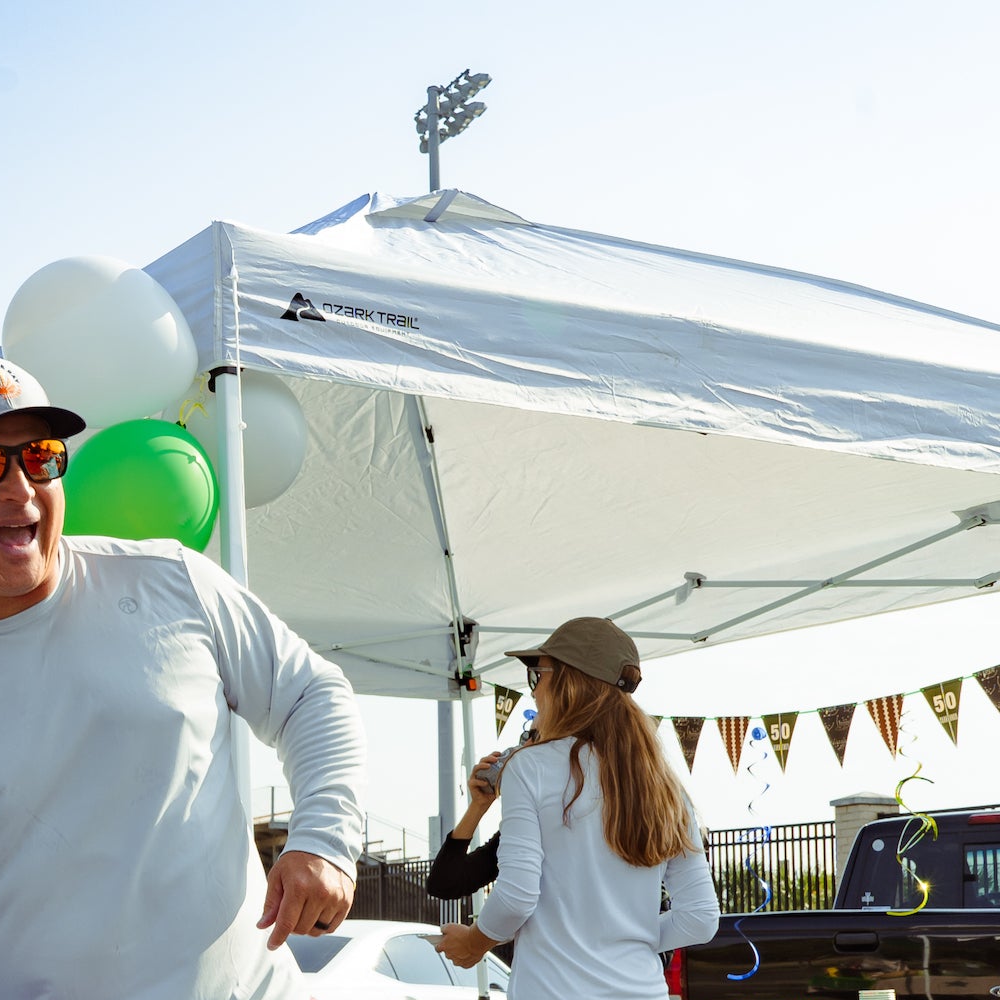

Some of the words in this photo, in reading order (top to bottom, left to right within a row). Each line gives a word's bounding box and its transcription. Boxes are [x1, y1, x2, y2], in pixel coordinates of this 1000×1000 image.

[496, 695, 514, 713] 50
[932, 692, 957, 713] 50
[770, 723, 791, 741] 50
